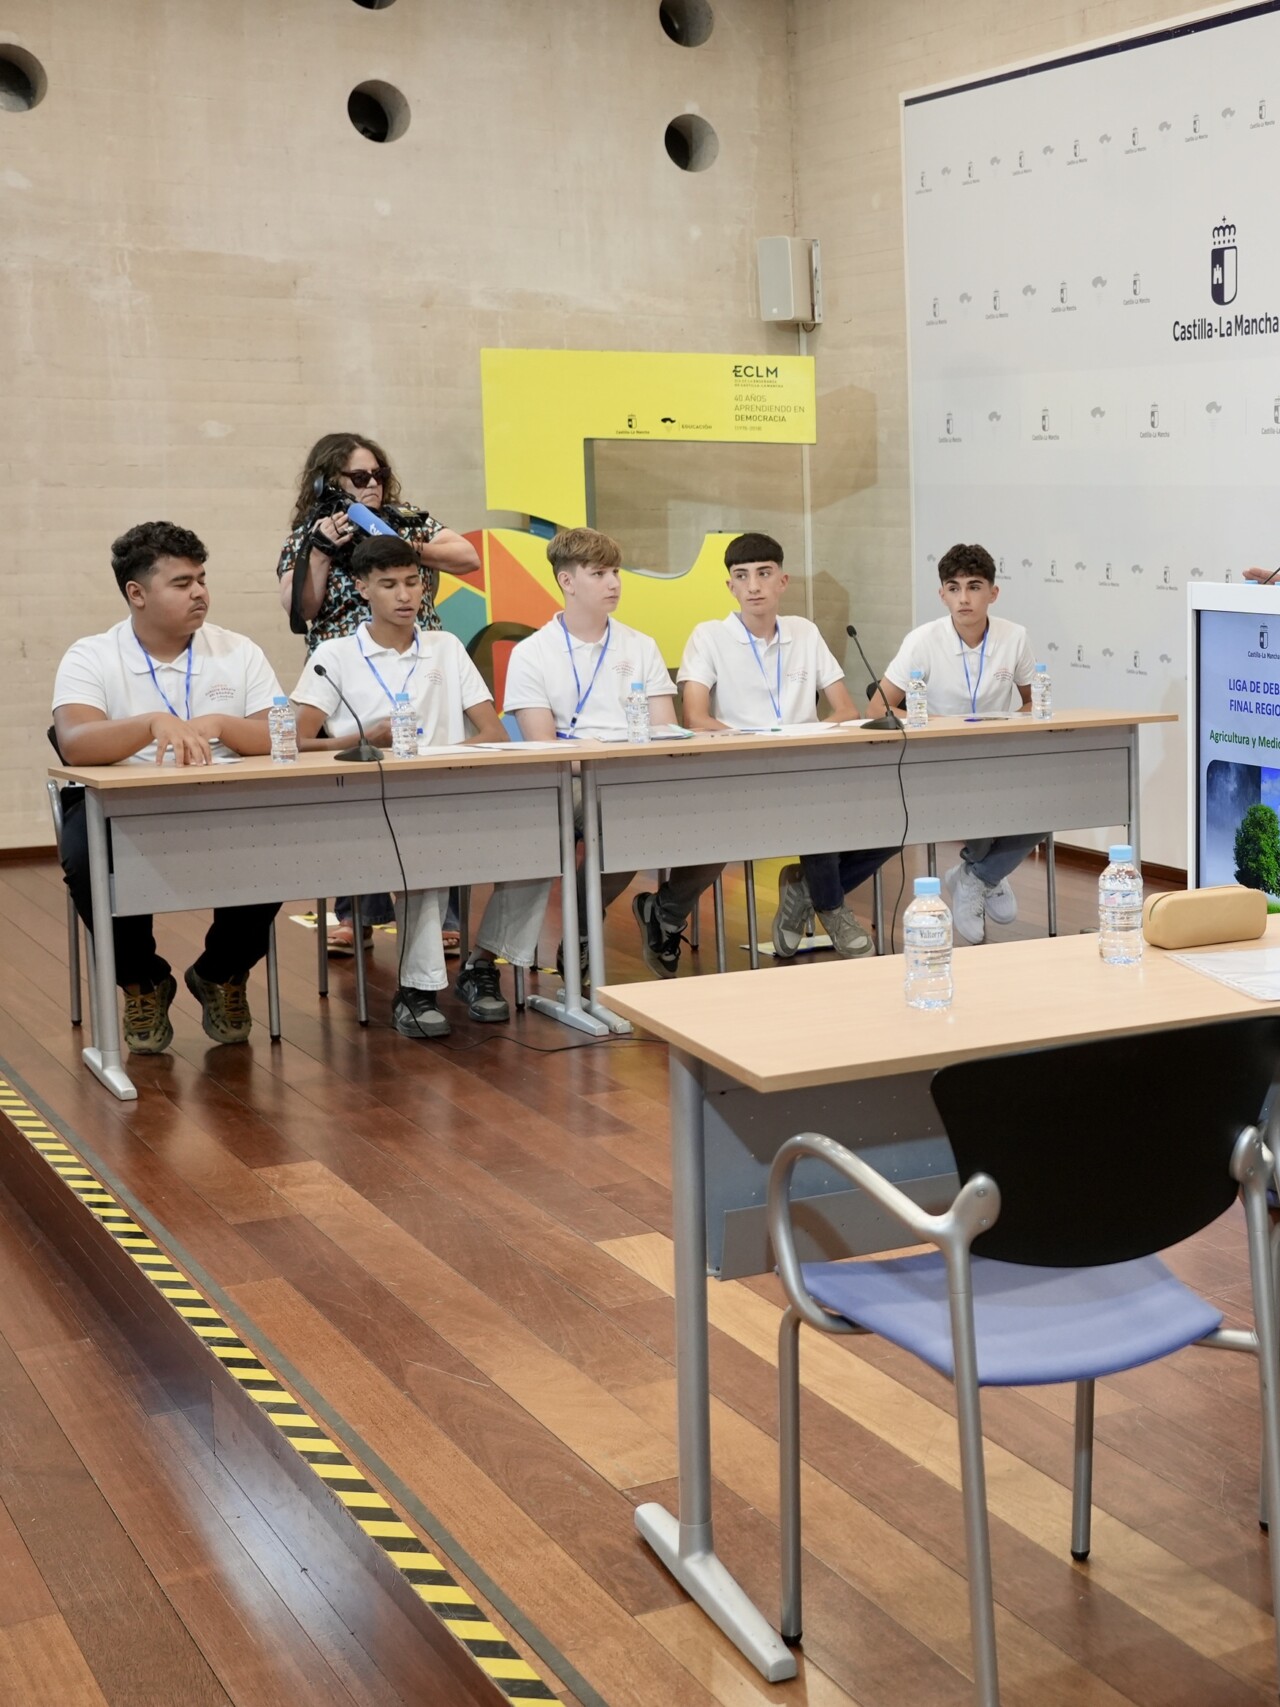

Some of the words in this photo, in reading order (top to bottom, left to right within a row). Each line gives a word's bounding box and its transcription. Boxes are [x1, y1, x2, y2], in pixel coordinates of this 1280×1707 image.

[1172, 316, 1232, 342] Castilla-La
[1234, 312, 1279, 336] Mancha
[733, 366, 778, 378] ECLM
[745, 394, 767, 402] AÑOS
[734, 404, 792, 413] APRENDIENDO
[1228, 678, 1248, 692] LIGA
[1250, 680, 1261, 694] DE
[1229, 699, 1254, 714] FINAL
[1209, 729, 1250, 746] Agricultura
[1251, 736, 1256, 748] y
